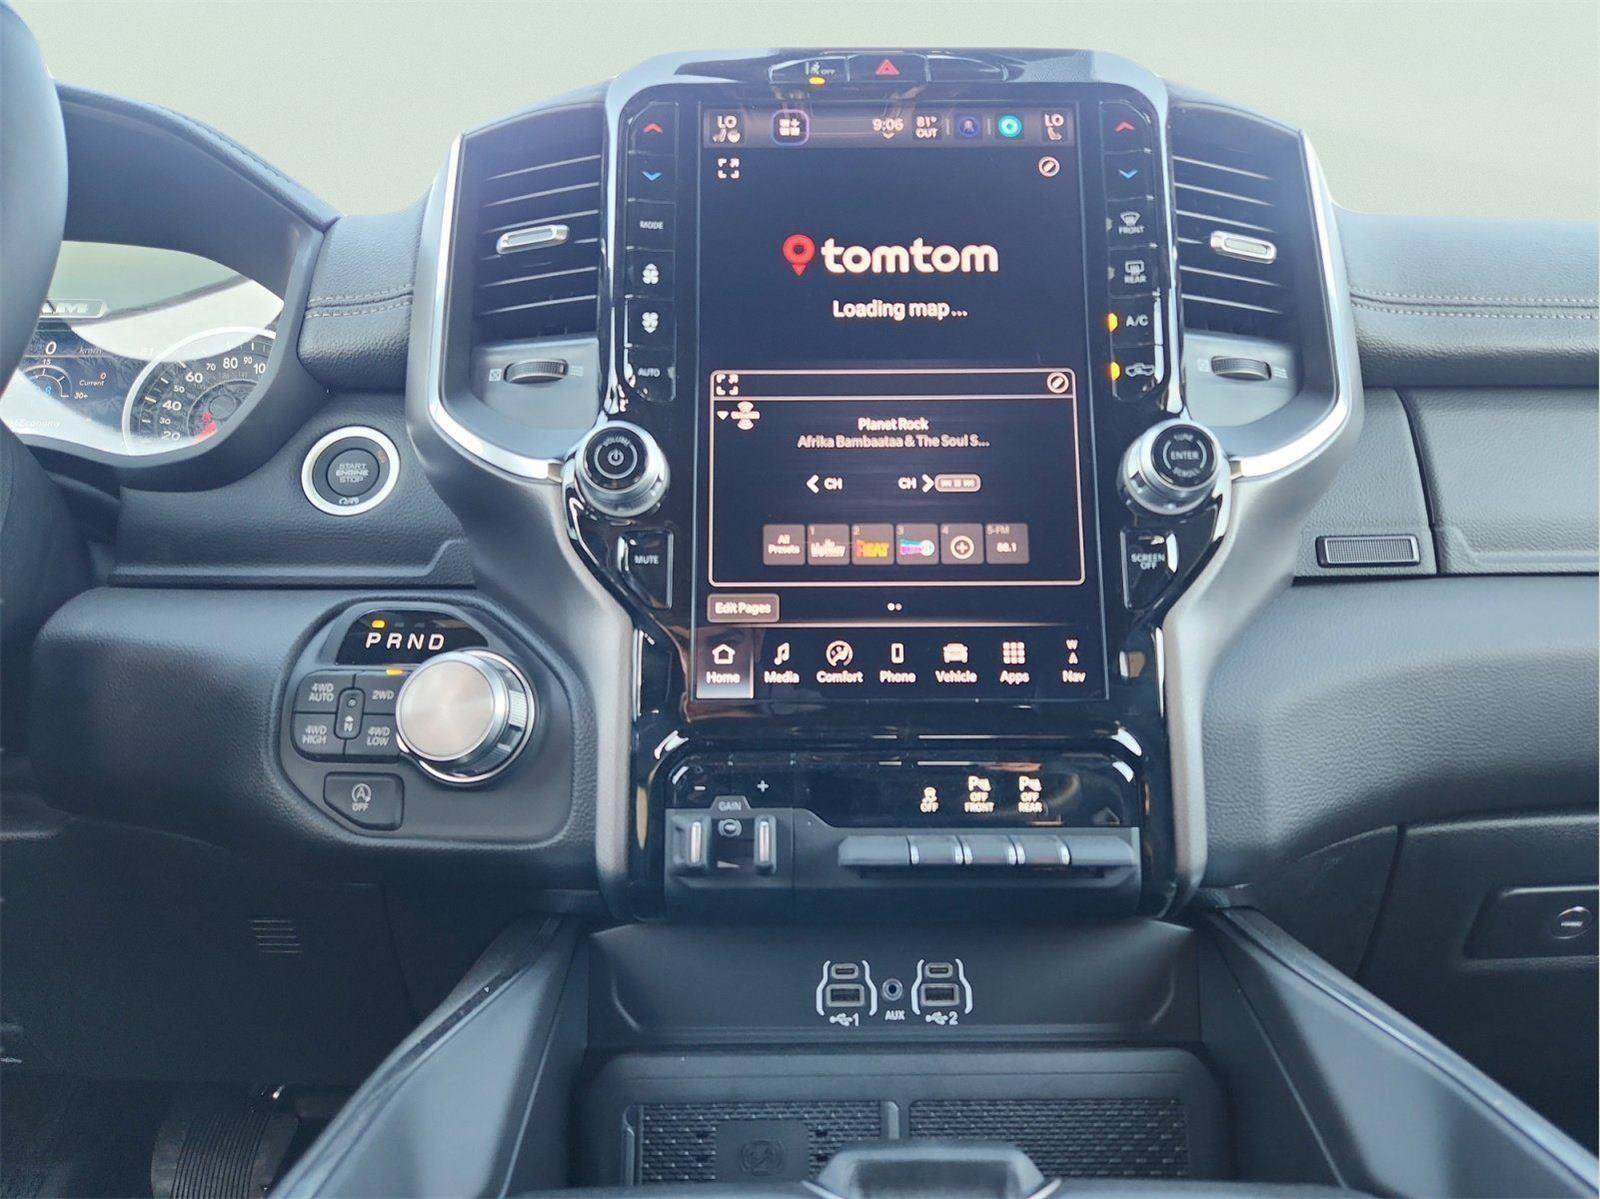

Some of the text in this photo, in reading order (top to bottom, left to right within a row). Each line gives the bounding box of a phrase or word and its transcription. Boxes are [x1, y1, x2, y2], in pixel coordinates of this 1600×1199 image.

[716, 115, 738, 129] LO
[1044, 113, 1065, 127] LO
[915, 128, 938, 139] OUT
[639, 220, 664, 230] MODE
[1118, 226, 1145, 235] FRONT
[821, 236, 999, 274] tomtom
[1124, 275, 1147, 284] REAR
[833, 300, 968, 321] Loading map...
[1126, 313, 1149, 328] A/C
[45, 340, 57, 355] 0
[223, 357, 238, 369] 80
[243, 356, 253, 365] 90
[206, 362, 216, 372] 70
[637, 368, 661, 378] AUTO
[79, 379, 105, 387] Current
[185, 371, 203, 383] 60
[173, 385, 186, 394] 50
[162, 399, 182, 412] 40
[159, 417, 172, 425] 30
[858, 417, 930, 431] Planet Rock
[161, 430, 182, 441] 20
[797, 435, 834, 448] Afrika
[836, 435, 904, 448] Bambaataa
[905, 436, 916, 447] &
[916, 435, 940, 448] The
[941, 434, 969, 448] Soul
[1170, 451, 1200, 461] ENTER
[336, 469, 369, 477] ENGINE
[823, 477, 843, 490] CH
[898, 477, 918, 490] CH
[776, 534, 792, 545] All
[634, 555, 659, 565] MUTE
[1131, 552, 1166, 563] SCREEN
[1140, 562, 1157, 570] OFF
[714, 602, 772, 616] Edit Pages
[706, 671, 741, 684] Home
[763, 670, 800, 684] Media
[816, 670, 864, 684] Comfort
[879, 670, 917, 683] Phone
[935, 669, 978, 683] Vehicle
[999, 669, 1030, 685] Apps
[1061, 669, 1086, 683] Nav
[311, 682, 335, 692] 4WD
[308, 692, 335, 702] AUTO
[371, 689, 395, 701] 2WD
[304, 724, 328, 735] 4WD
[367, 726, 391, 737] 4WD
[301, 734, 328, 745] HIGH
[366, 736, 390, 747] LOW
[352, 802, 370, 812] OFF
[718, 801, 742, 812] GAIN
[1017, 801, 1044, 813] REAR
[852, 1012, 860, 1027] 1
[884, 1009, 906, 1021] AUX
[948, 1010, 959, 1026] 2
